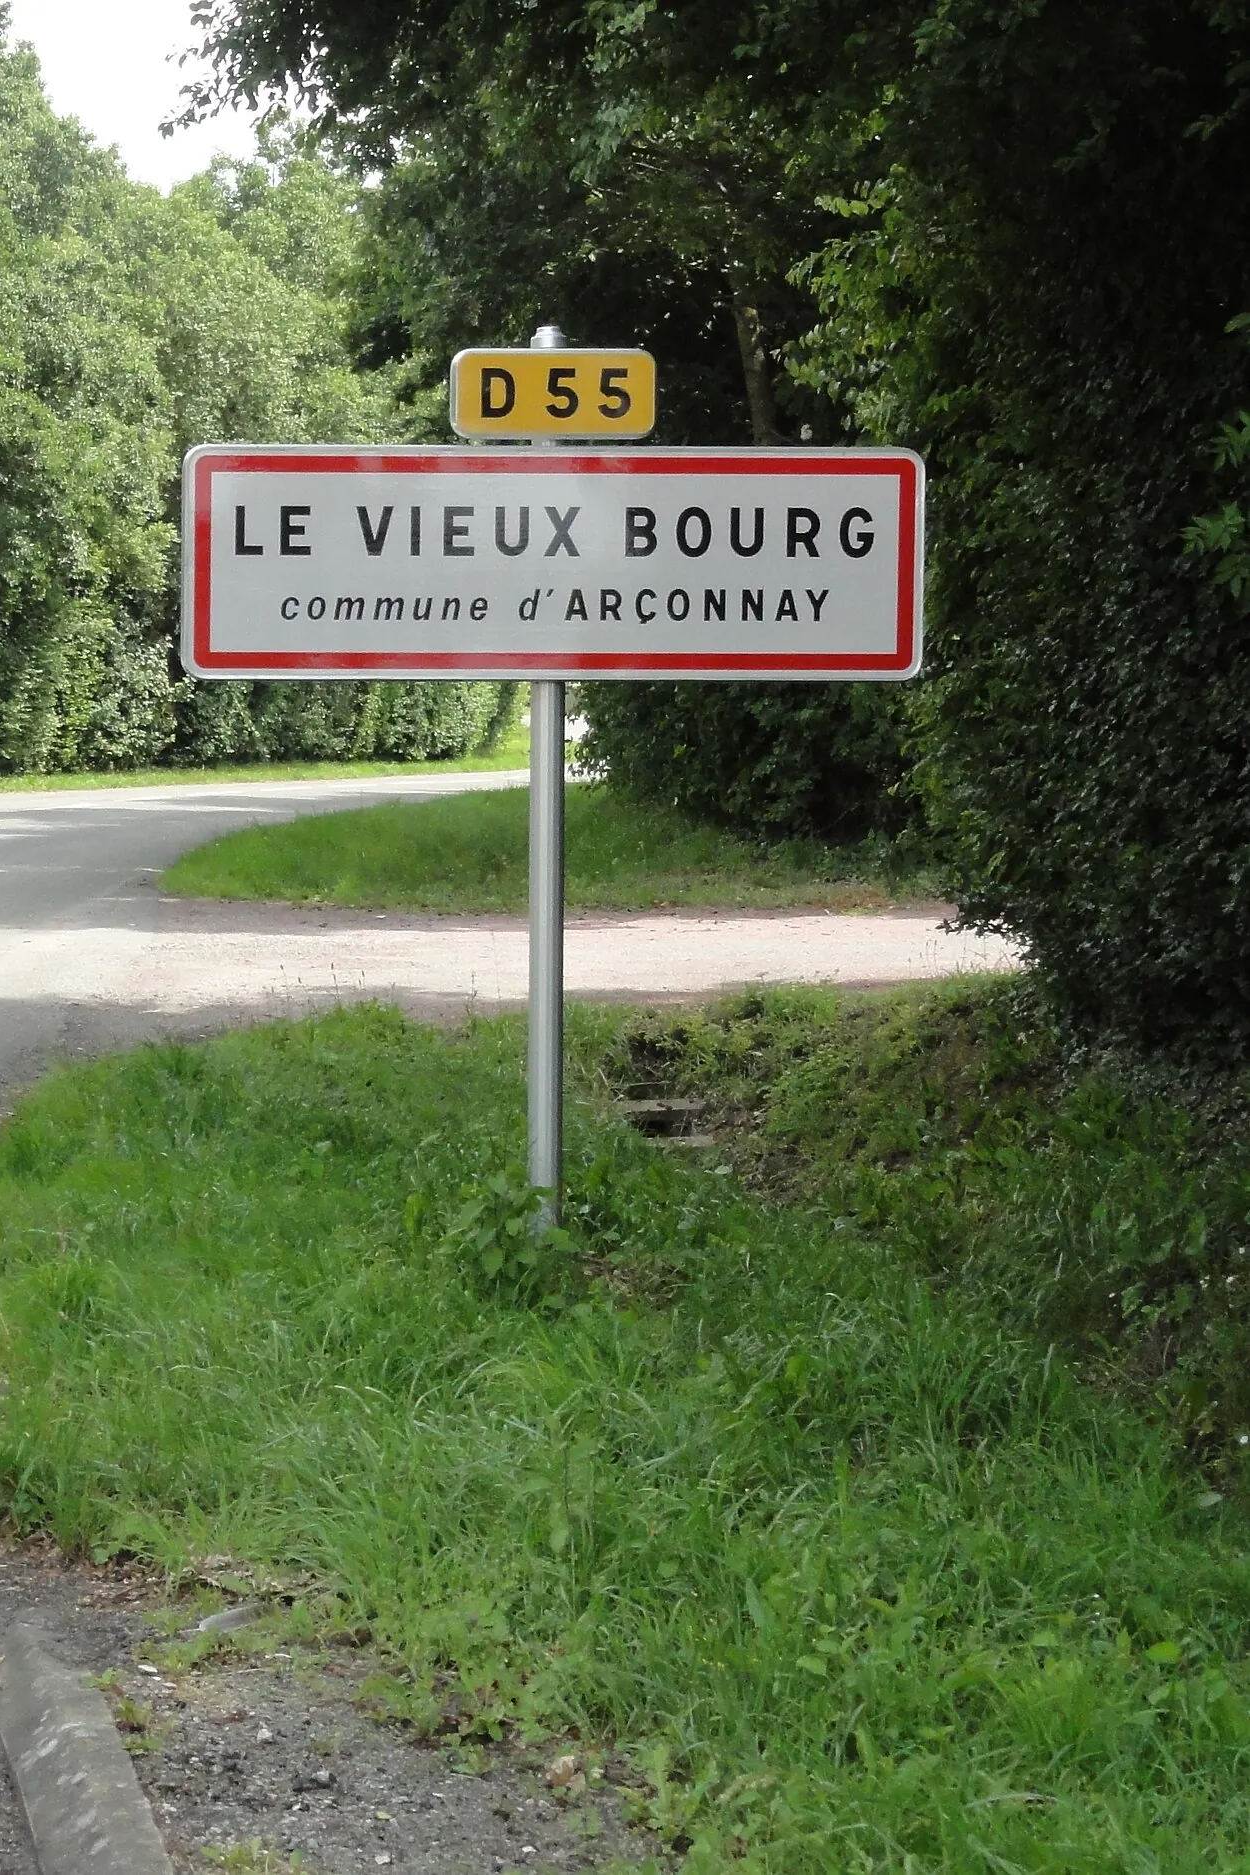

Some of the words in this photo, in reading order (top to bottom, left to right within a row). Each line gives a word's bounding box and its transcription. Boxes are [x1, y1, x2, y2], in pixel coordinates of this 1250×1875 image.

[480, 367, 516, 419] D
[545, 367, 632, 419] 55
[234, 505, 312, 556] LE
[356, 505, 581, 557] VIEUX
[624, 506, 875, 559] BOURG
[280, 596, 489, 622] commune
[518, 588, 830, 624] d'ARÇONNAY
